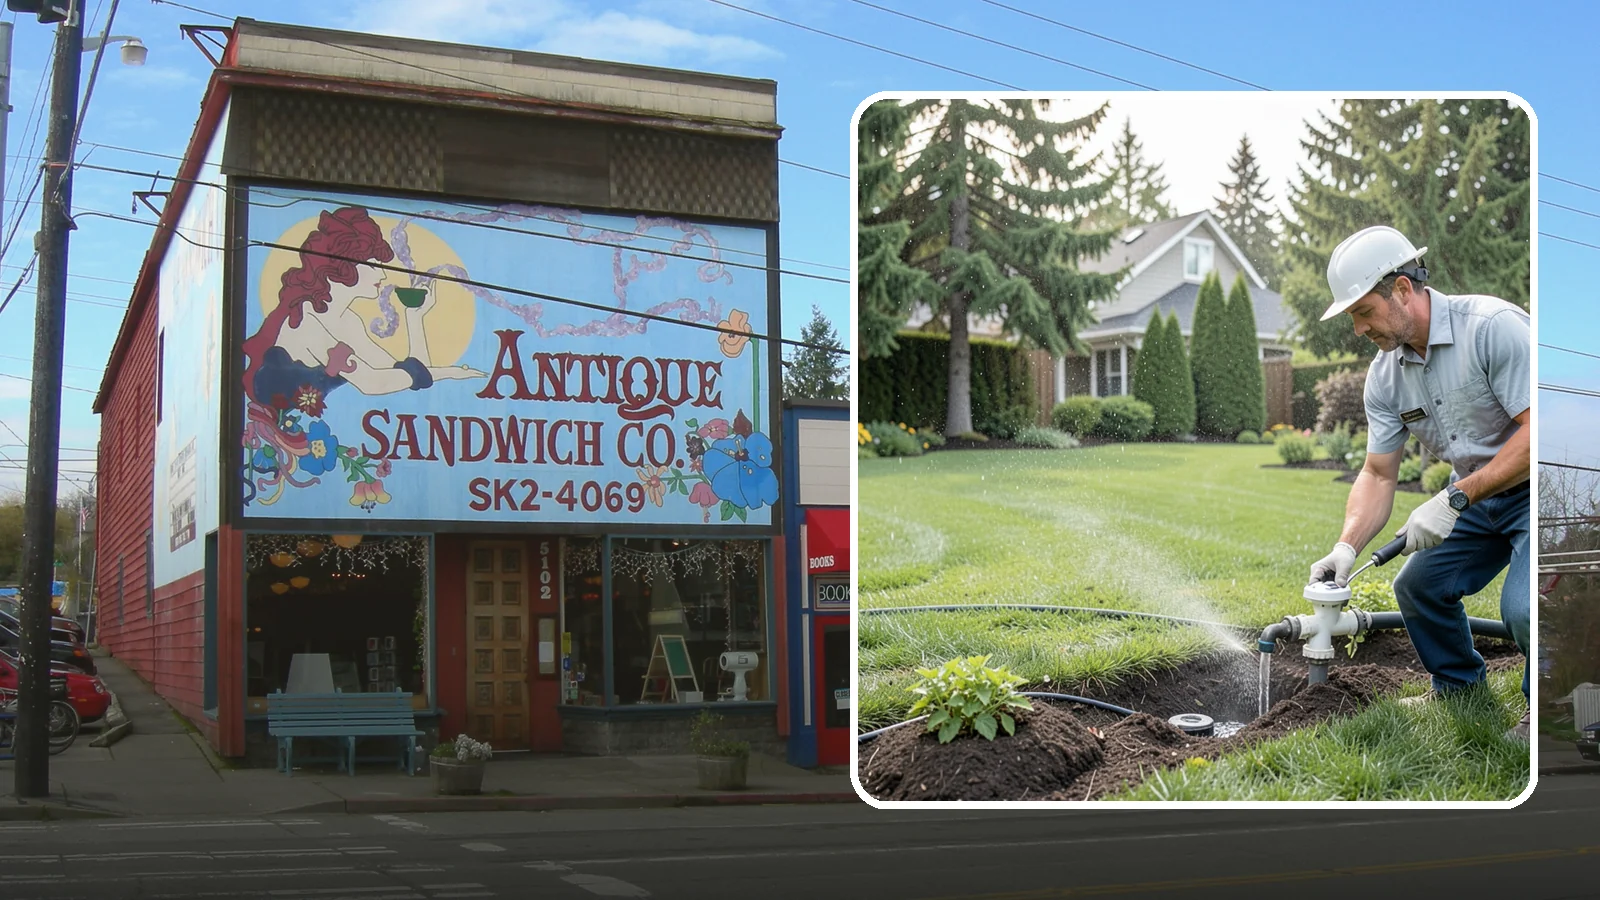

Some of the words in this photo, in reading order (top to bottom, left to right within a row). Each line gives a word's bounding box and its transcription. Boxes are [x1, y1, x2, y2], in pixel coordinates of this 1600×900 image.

[475, 329, 723, 420] ANTIQUE
[361, 408, 604, 466] SANDWICH
[617, 423, 685, 468] CO.
[468, 477, 646, 512] SK2-4069
[540, 541, 551, 599] 5102
[809, 555, 835, 569] BOOKS
